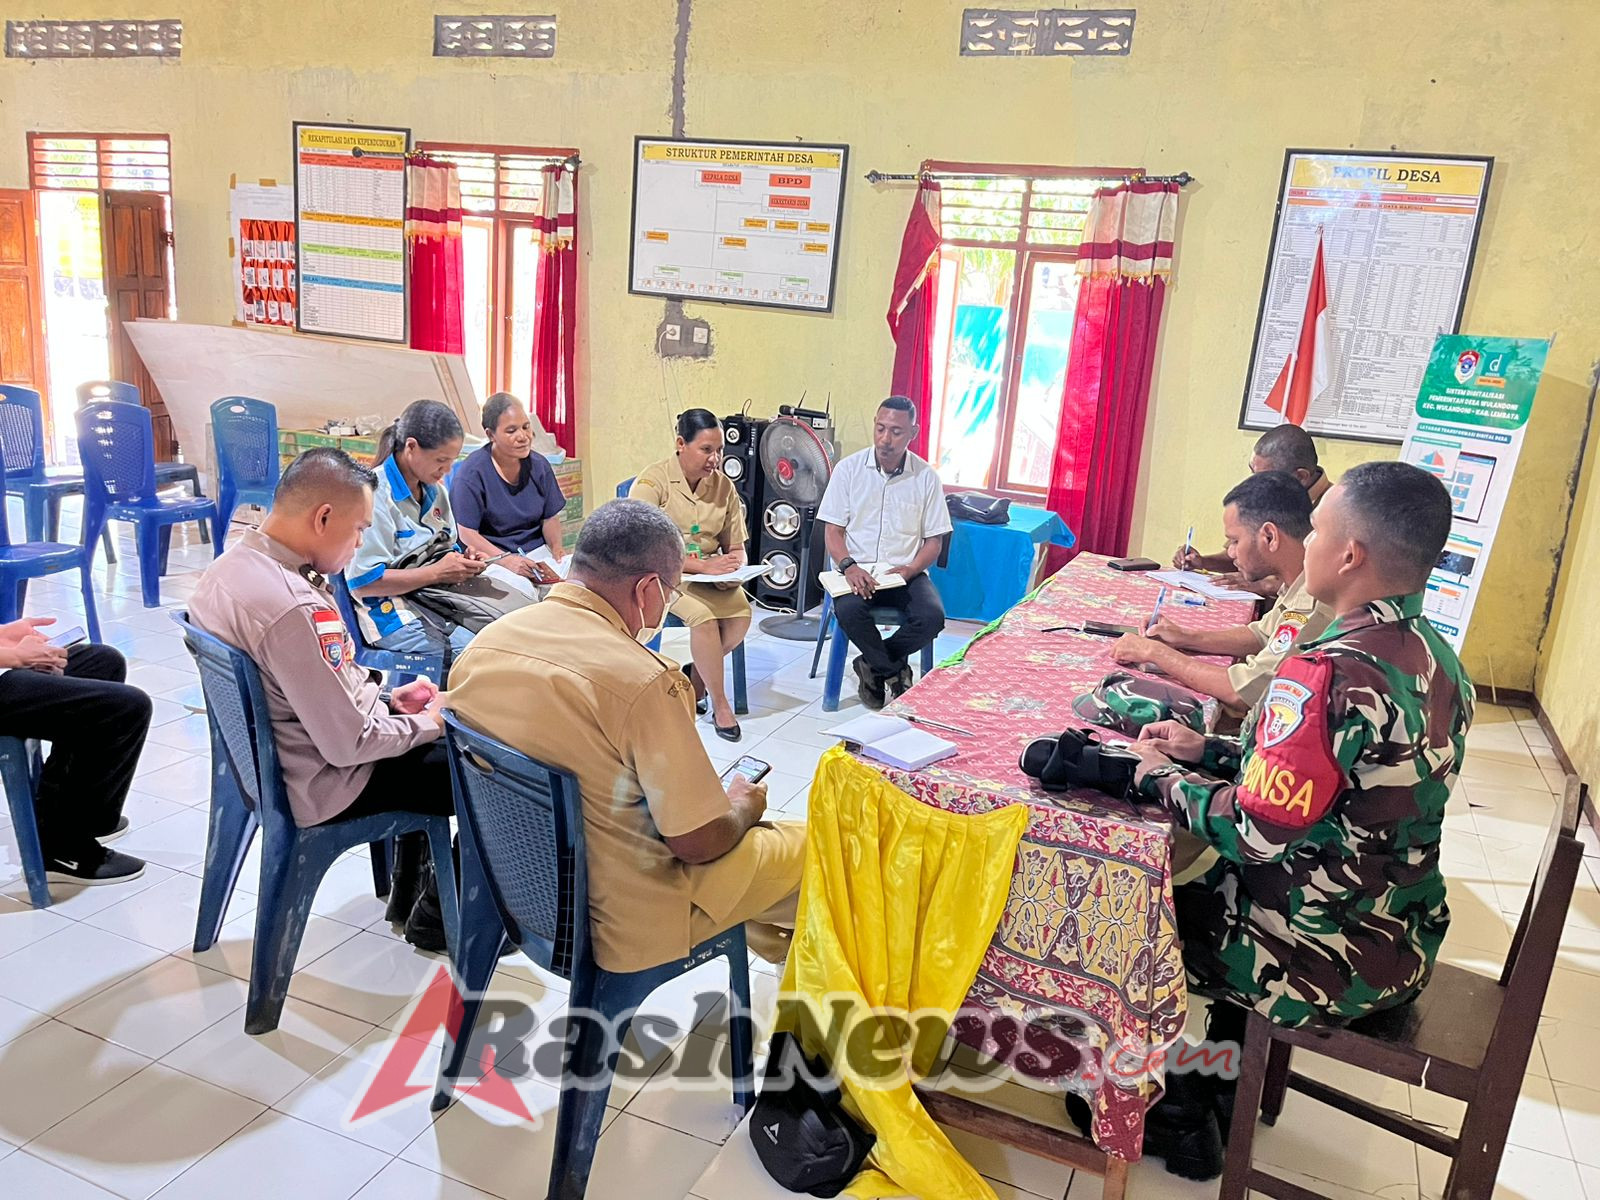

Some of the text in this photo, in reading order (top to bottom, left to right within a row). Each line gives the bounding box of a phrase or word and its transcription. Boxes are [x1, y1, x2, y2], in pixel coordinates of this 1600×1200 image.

[308, 134, 396, 147] REKAPITULASI DATA KEPENDUDUKAN
[666, 149, 814, 164] STRUKTUR PEMERINTAH DESA
[778, 177, 803, 185] BPD
[1333, 166, 1441, 183] PROFIL DESA
[1446, 388, 1505, 400] SISTEM DIGITALISASI
[1428, 395, 1519, 411] PEMERINTAH DESA WULANDONI
[1436, 404, 1472, 414] WULANDONI
[1475, 408, 1489, 416] KAB.
[1490, 410, 1519, 421] LEMBATA
[1420, 424, 1441, 432] LAYANAN
[1441, 427, 1475, 437] TRANSFORMASI
[1475, 432, 1494, 440] DIGITAL
